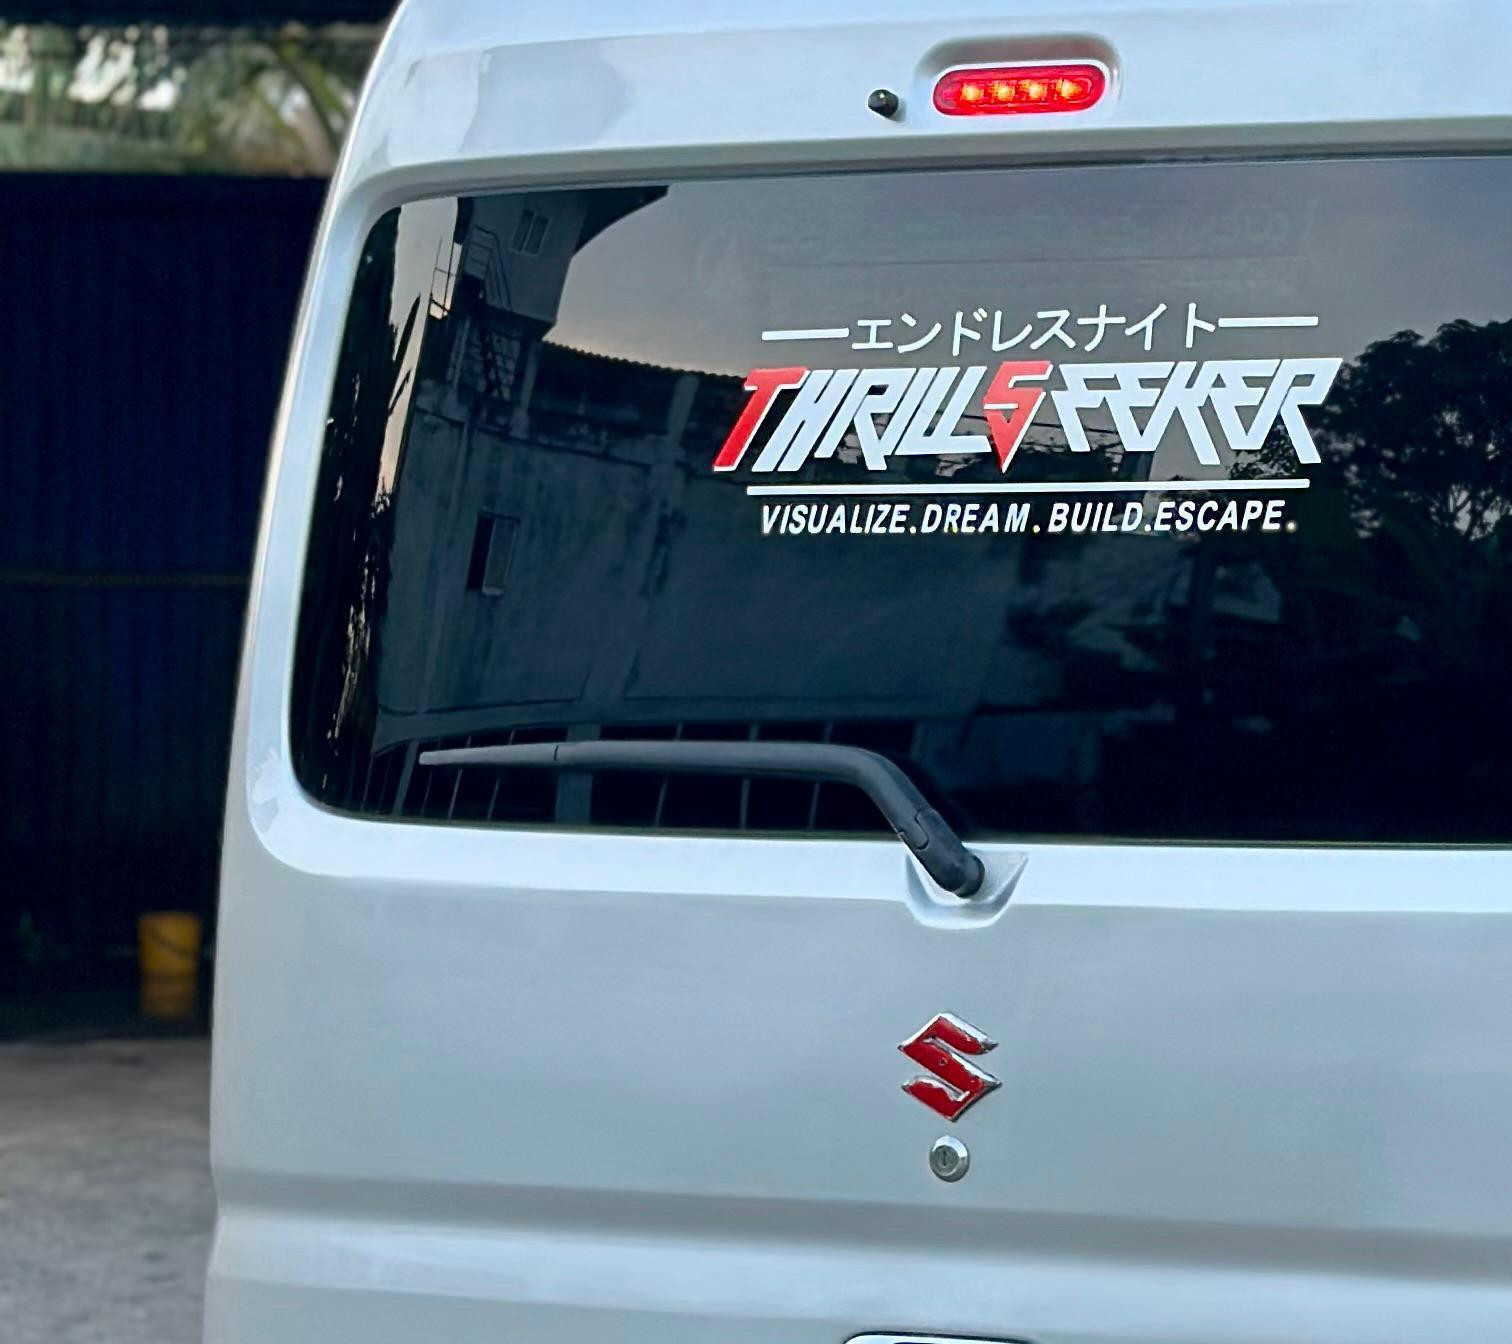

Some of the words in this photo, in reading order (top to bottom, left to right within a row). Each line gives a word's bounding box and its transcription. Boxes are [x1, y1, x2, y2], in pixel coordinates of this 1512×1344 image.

[850, 302, 1216, 357] エンドレスナイト
